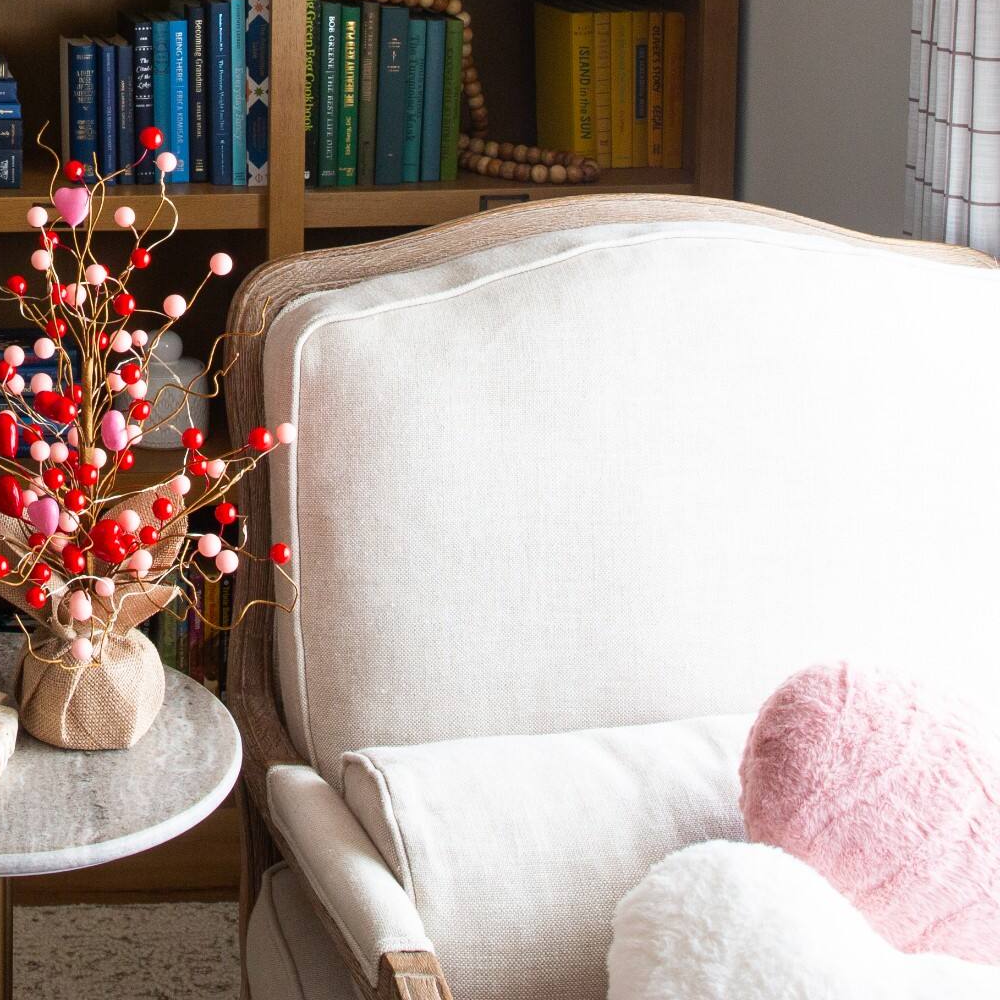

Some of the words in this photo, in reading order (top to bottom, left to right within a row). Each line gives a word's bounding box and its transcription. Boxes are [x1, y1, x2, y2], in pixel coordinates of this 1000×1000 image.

[194, 19, 203, 57] Becoming
[306, 10, 315, 48] Green
[328, 16, 336, 33] BOB
[195, 58, 203, 92] Grandma
[579, 46, 591, 85] ISLAND
[306, 73, 315, 132] Cookbook
[580, 98, 591, 113] the
[326, 118, 334, 137] LIFE
[580, 115, 592, 140] SUN
[325, 139, 333, 160] DIET
